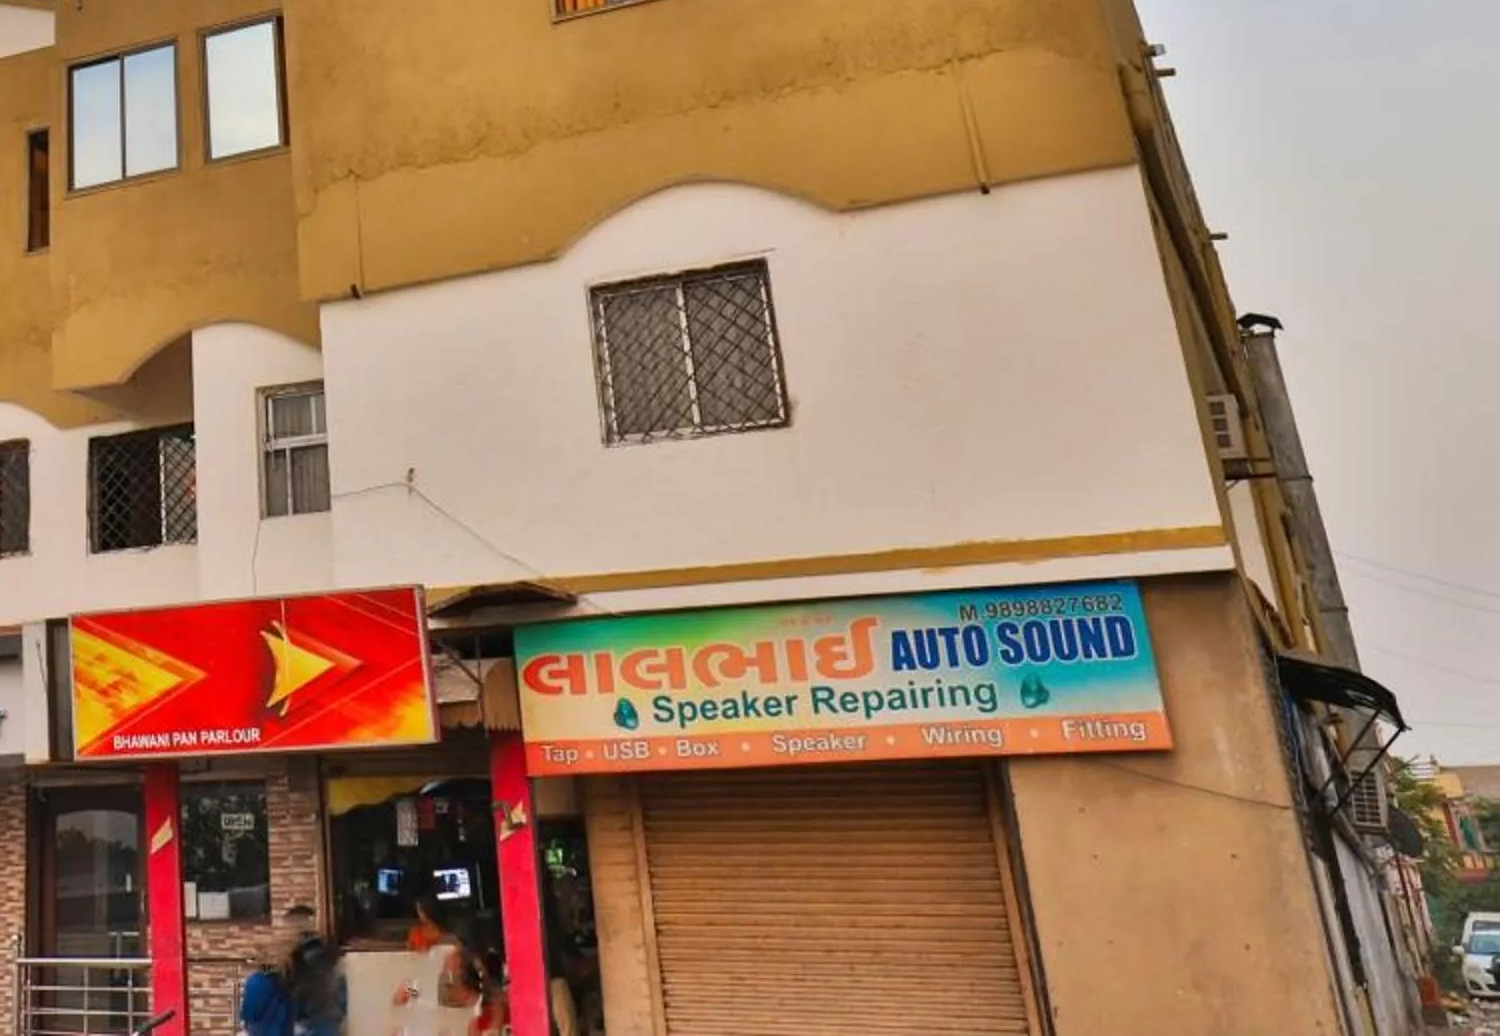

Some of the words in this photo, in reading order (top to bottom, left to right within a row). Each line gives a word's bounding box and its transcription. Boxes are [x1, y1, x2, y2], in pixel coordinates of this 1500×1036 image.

[890, 624, 990, 671] AUTO
[997, 614, 1136, 664] SOUND
[652, 689, 798, 729] Speaker
[811, 678, 999, 719] Repairing
[113, 732, 170, 749] BHAWANI
[172, 730, 197, 746] PAN
[201, 727, 261, 744] PARLOUR
[541, 745, 578, 765] Tap
[603, 739, 650, 760] USB
[675, 738, 719, 758] Box
[772, 732, 868, 756] Speaker
[922, 722, 1003, 747] Wiring
[1062, 717, 1147, 742] Fitting
